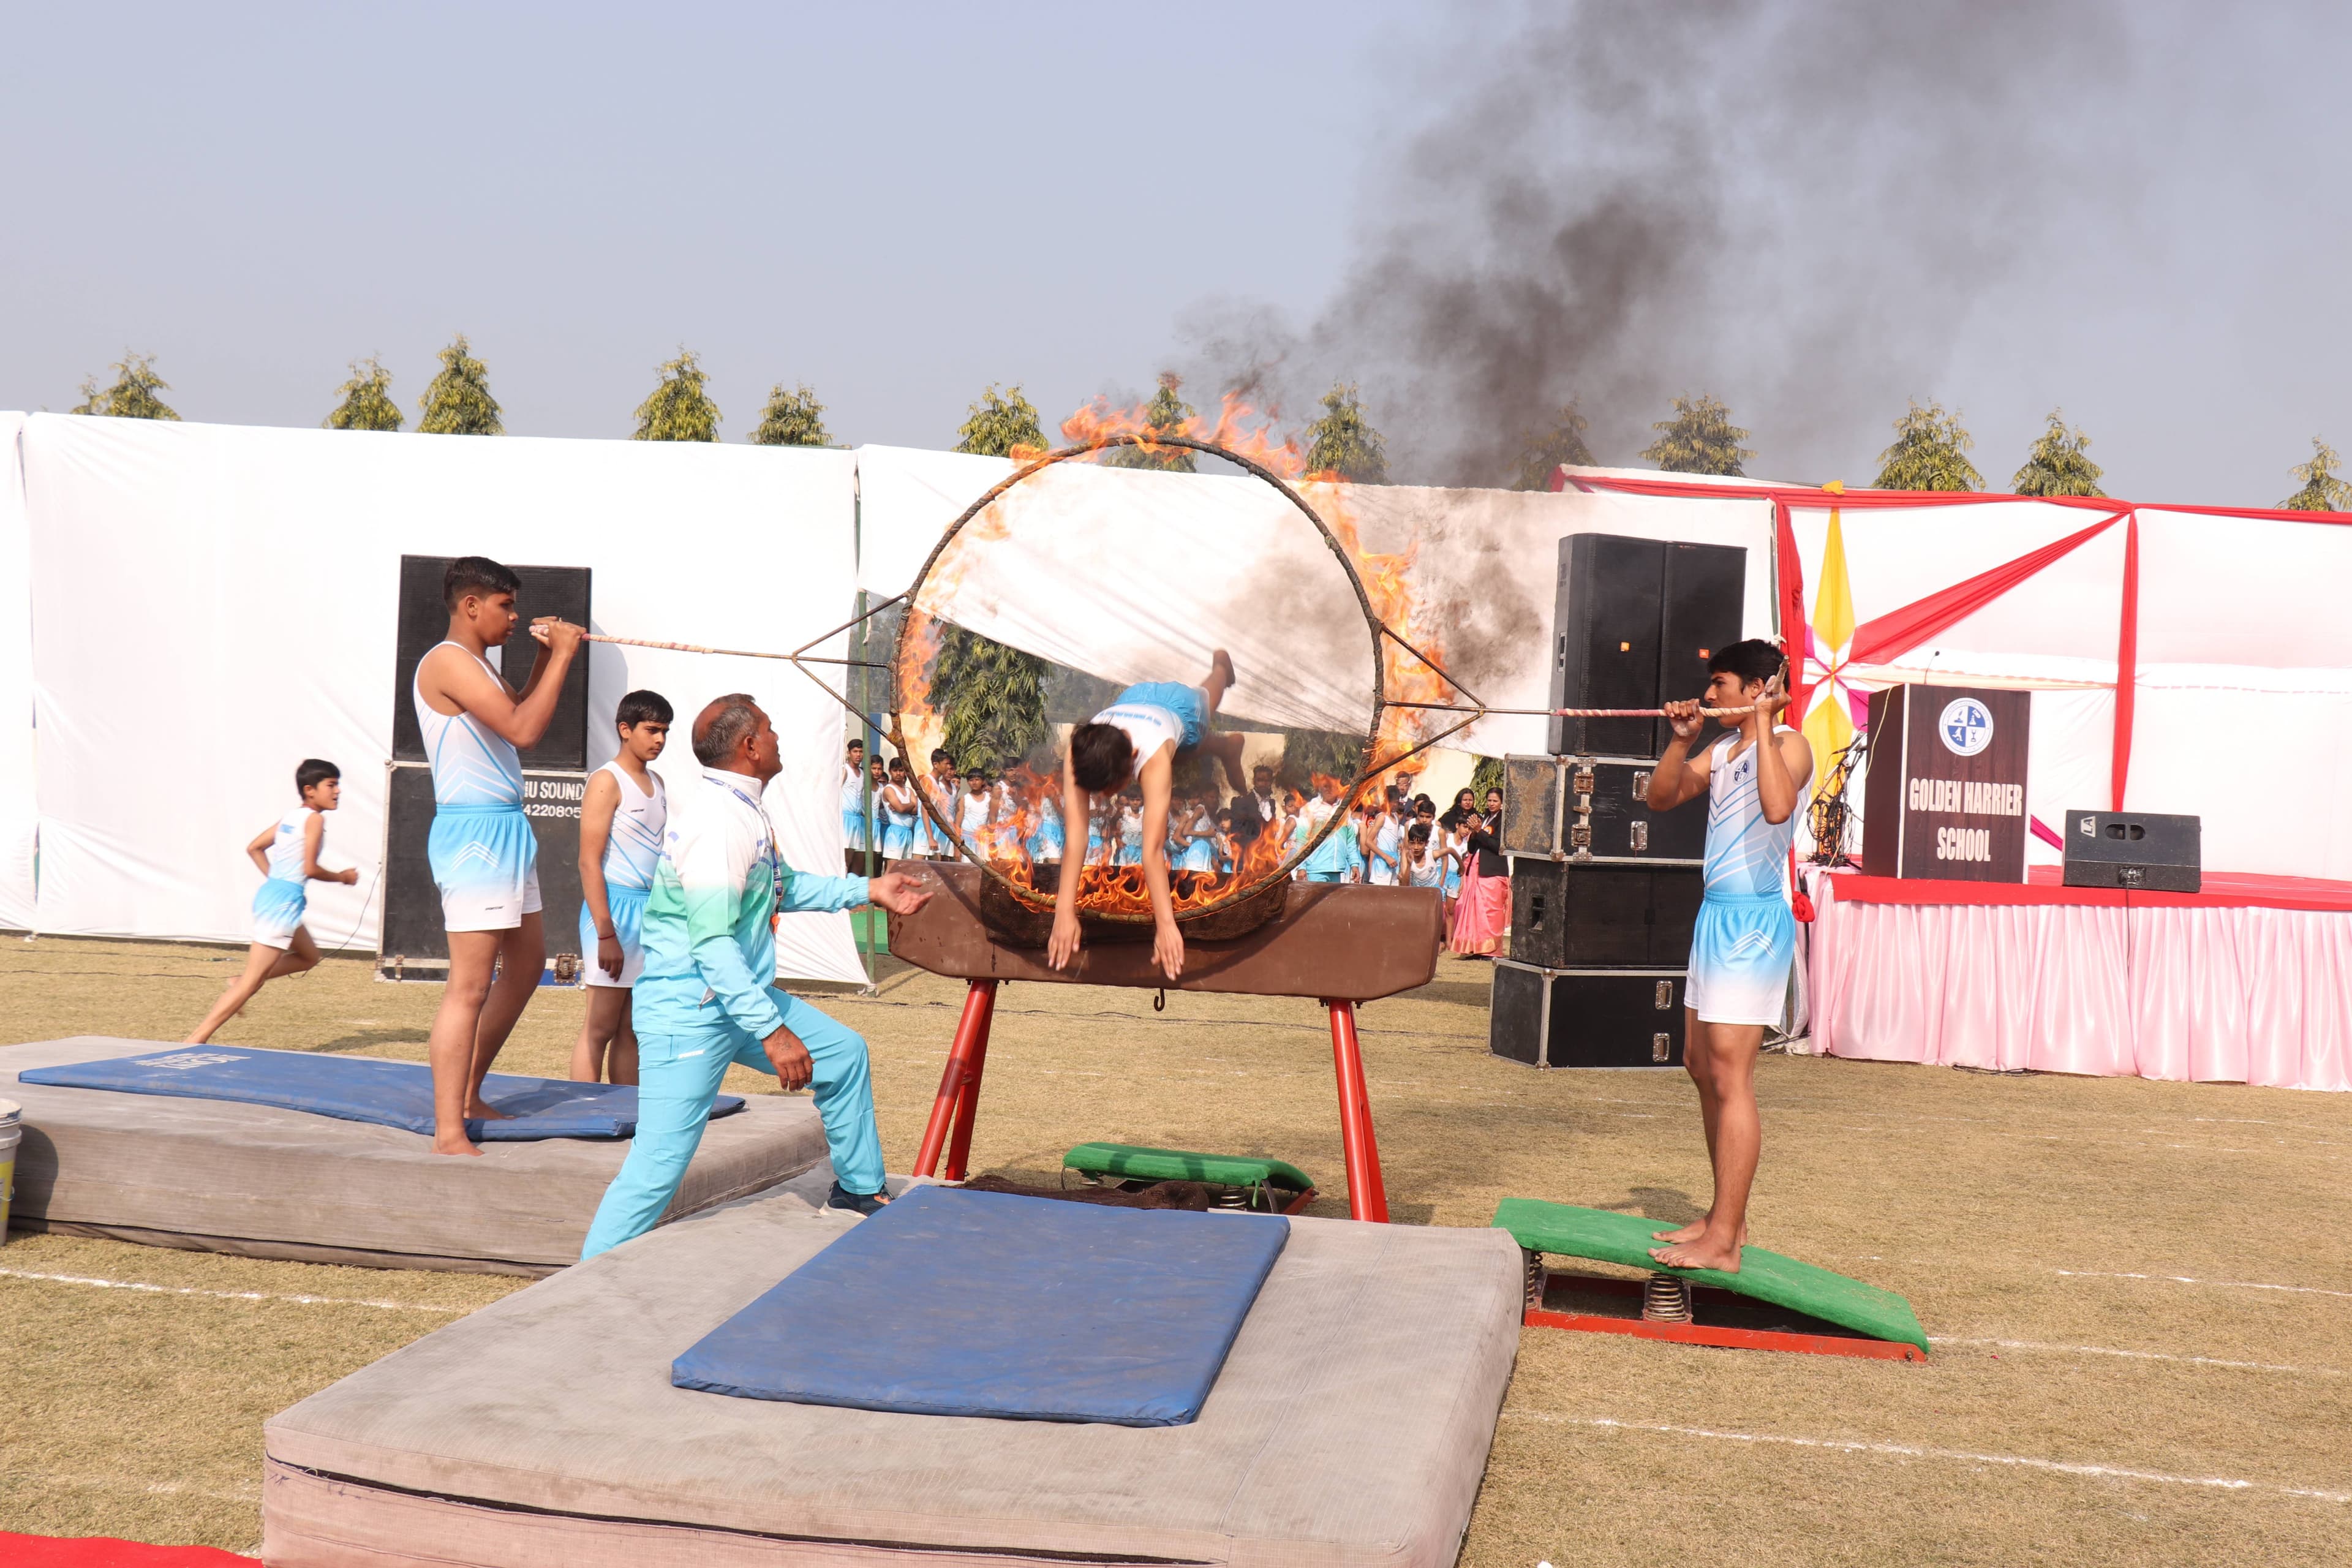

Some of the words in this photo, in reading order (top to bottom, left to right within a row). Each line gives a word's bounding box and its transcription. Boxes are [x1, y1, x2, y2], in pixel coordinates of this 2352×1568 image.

[540, 781, 585, 801] SOUND
[1909, 778, 1962, 813] GOLDEN
[1964, 782, 2022, 816] HARRIER
[522, 804, 581, 818] 4220805
[1937, 827, 1991, 862] SCHOOL
